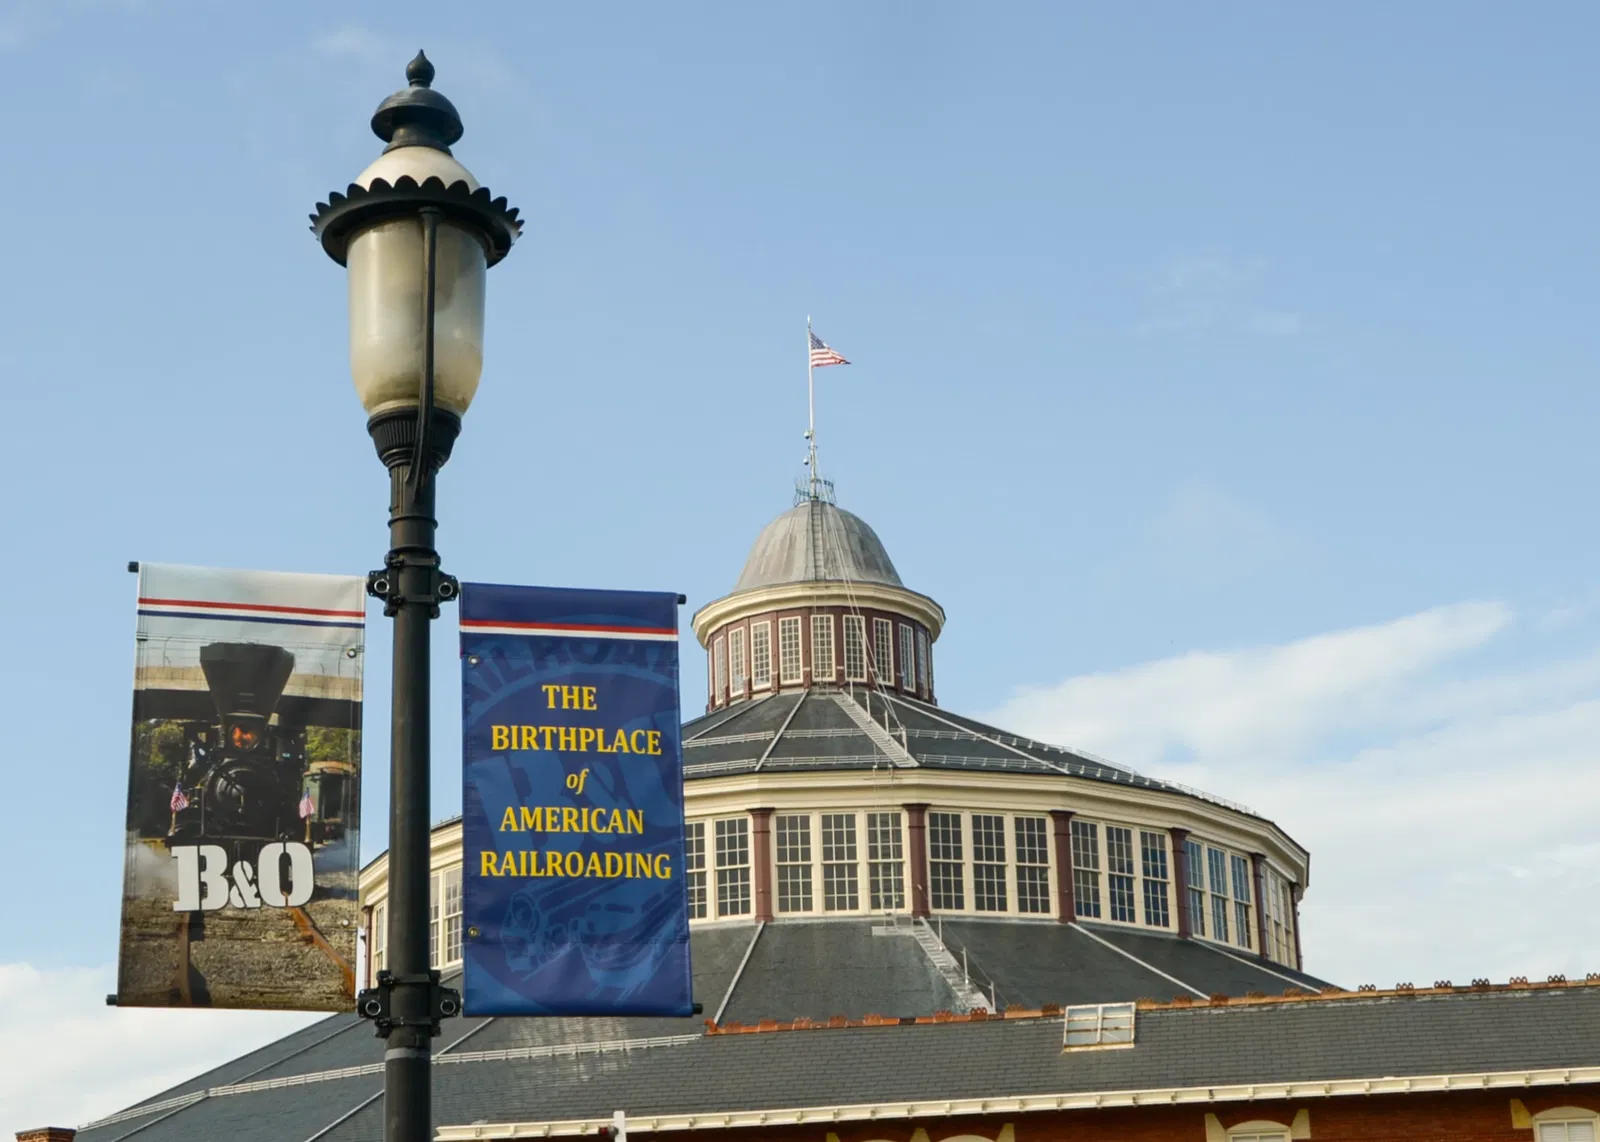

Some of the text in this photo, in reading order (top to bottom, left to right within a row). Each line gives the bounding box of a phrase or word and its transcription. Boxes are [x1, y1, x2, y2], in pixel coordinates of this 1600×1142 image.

[542, 684, 597, 711] THE
[491, 725, 662, 755] BIRTHPLACE
[566, 769, 589, 794] of
[499, 807, 644, 834] AMERICAN
[172, 842, 314, 912] B&O
[480, 851, 672, 880] RAILROADING
